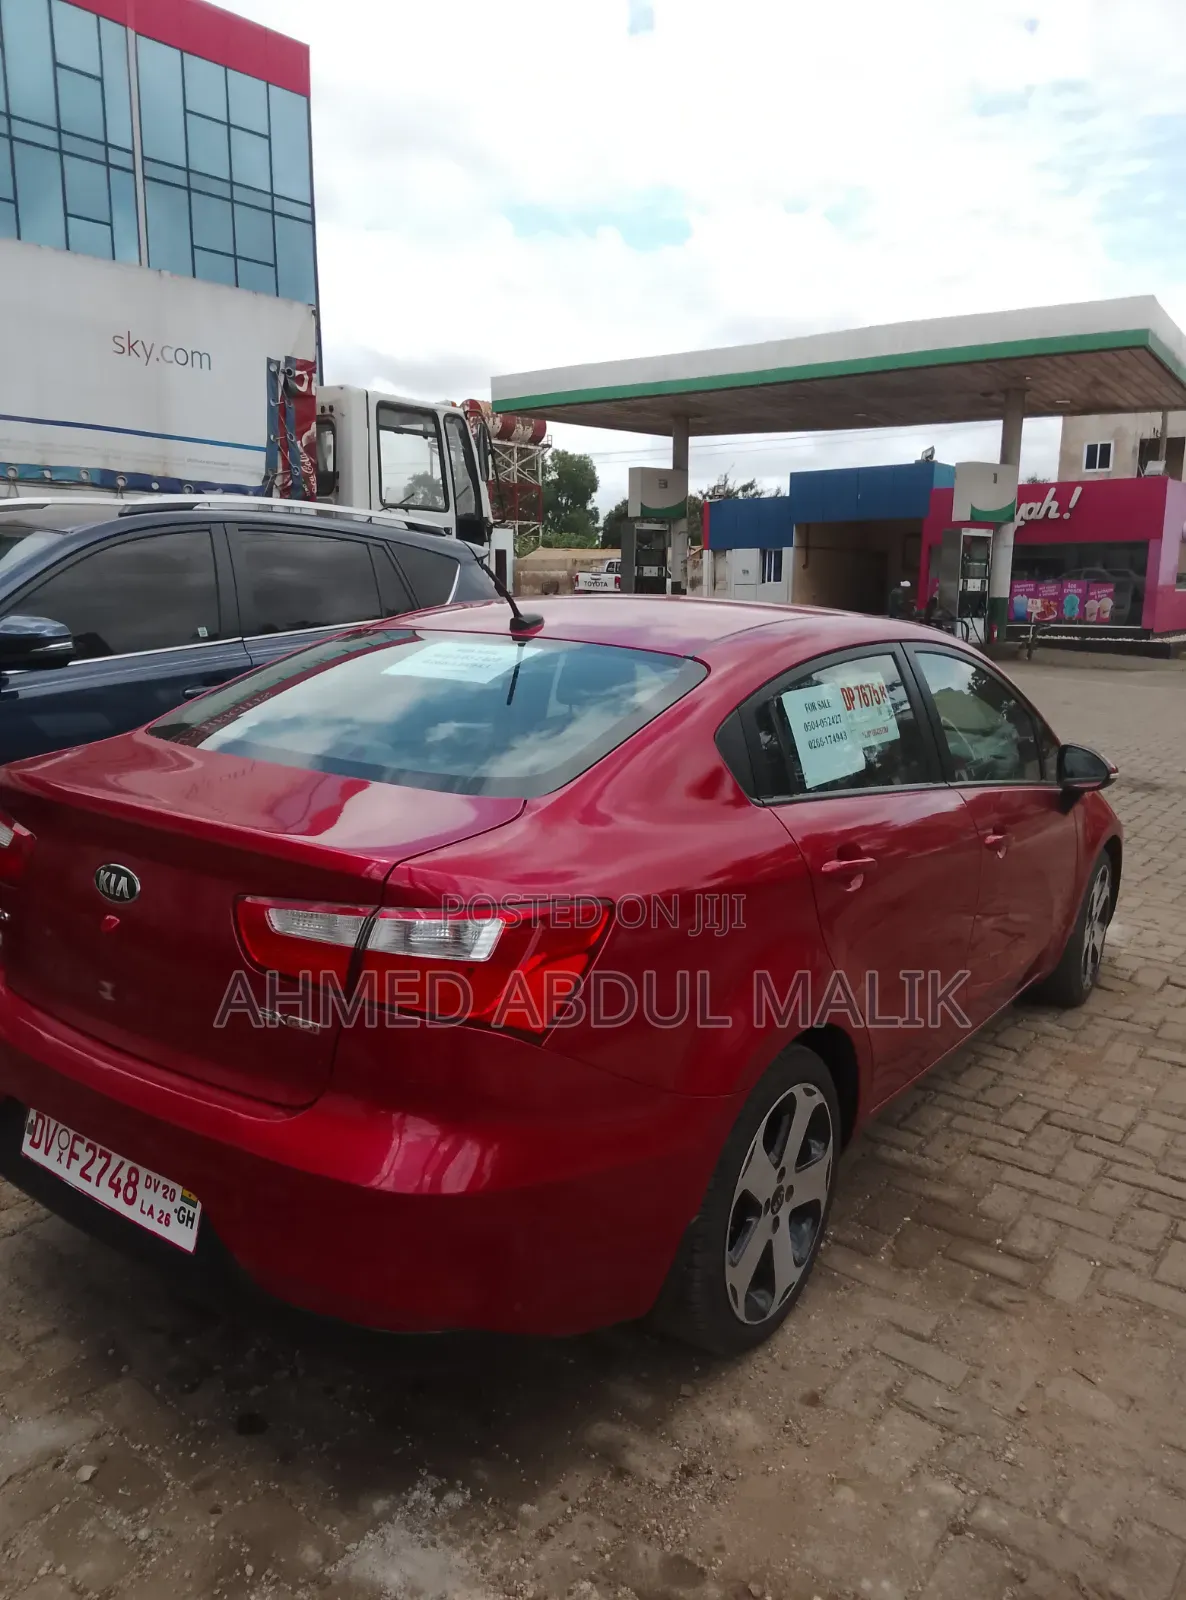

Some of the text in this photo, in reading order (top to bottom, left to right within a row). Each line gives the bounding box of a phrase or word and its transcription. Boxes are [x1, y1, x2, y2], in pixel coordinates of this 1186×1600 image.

[111, 330, 212, 371] sky.com
[583, 580, 609, 588] TOYOTA
[804, 699, 832, 713] FOR SALE
[98, 869, 130, 899] KIA
[29, 1111, 140, 1206] DV F2748
[144, 1174, 177, 1203] DV 20
[139, 1200, 171, 1228] LA 26
[176, 1206, 197, 1230] GH
